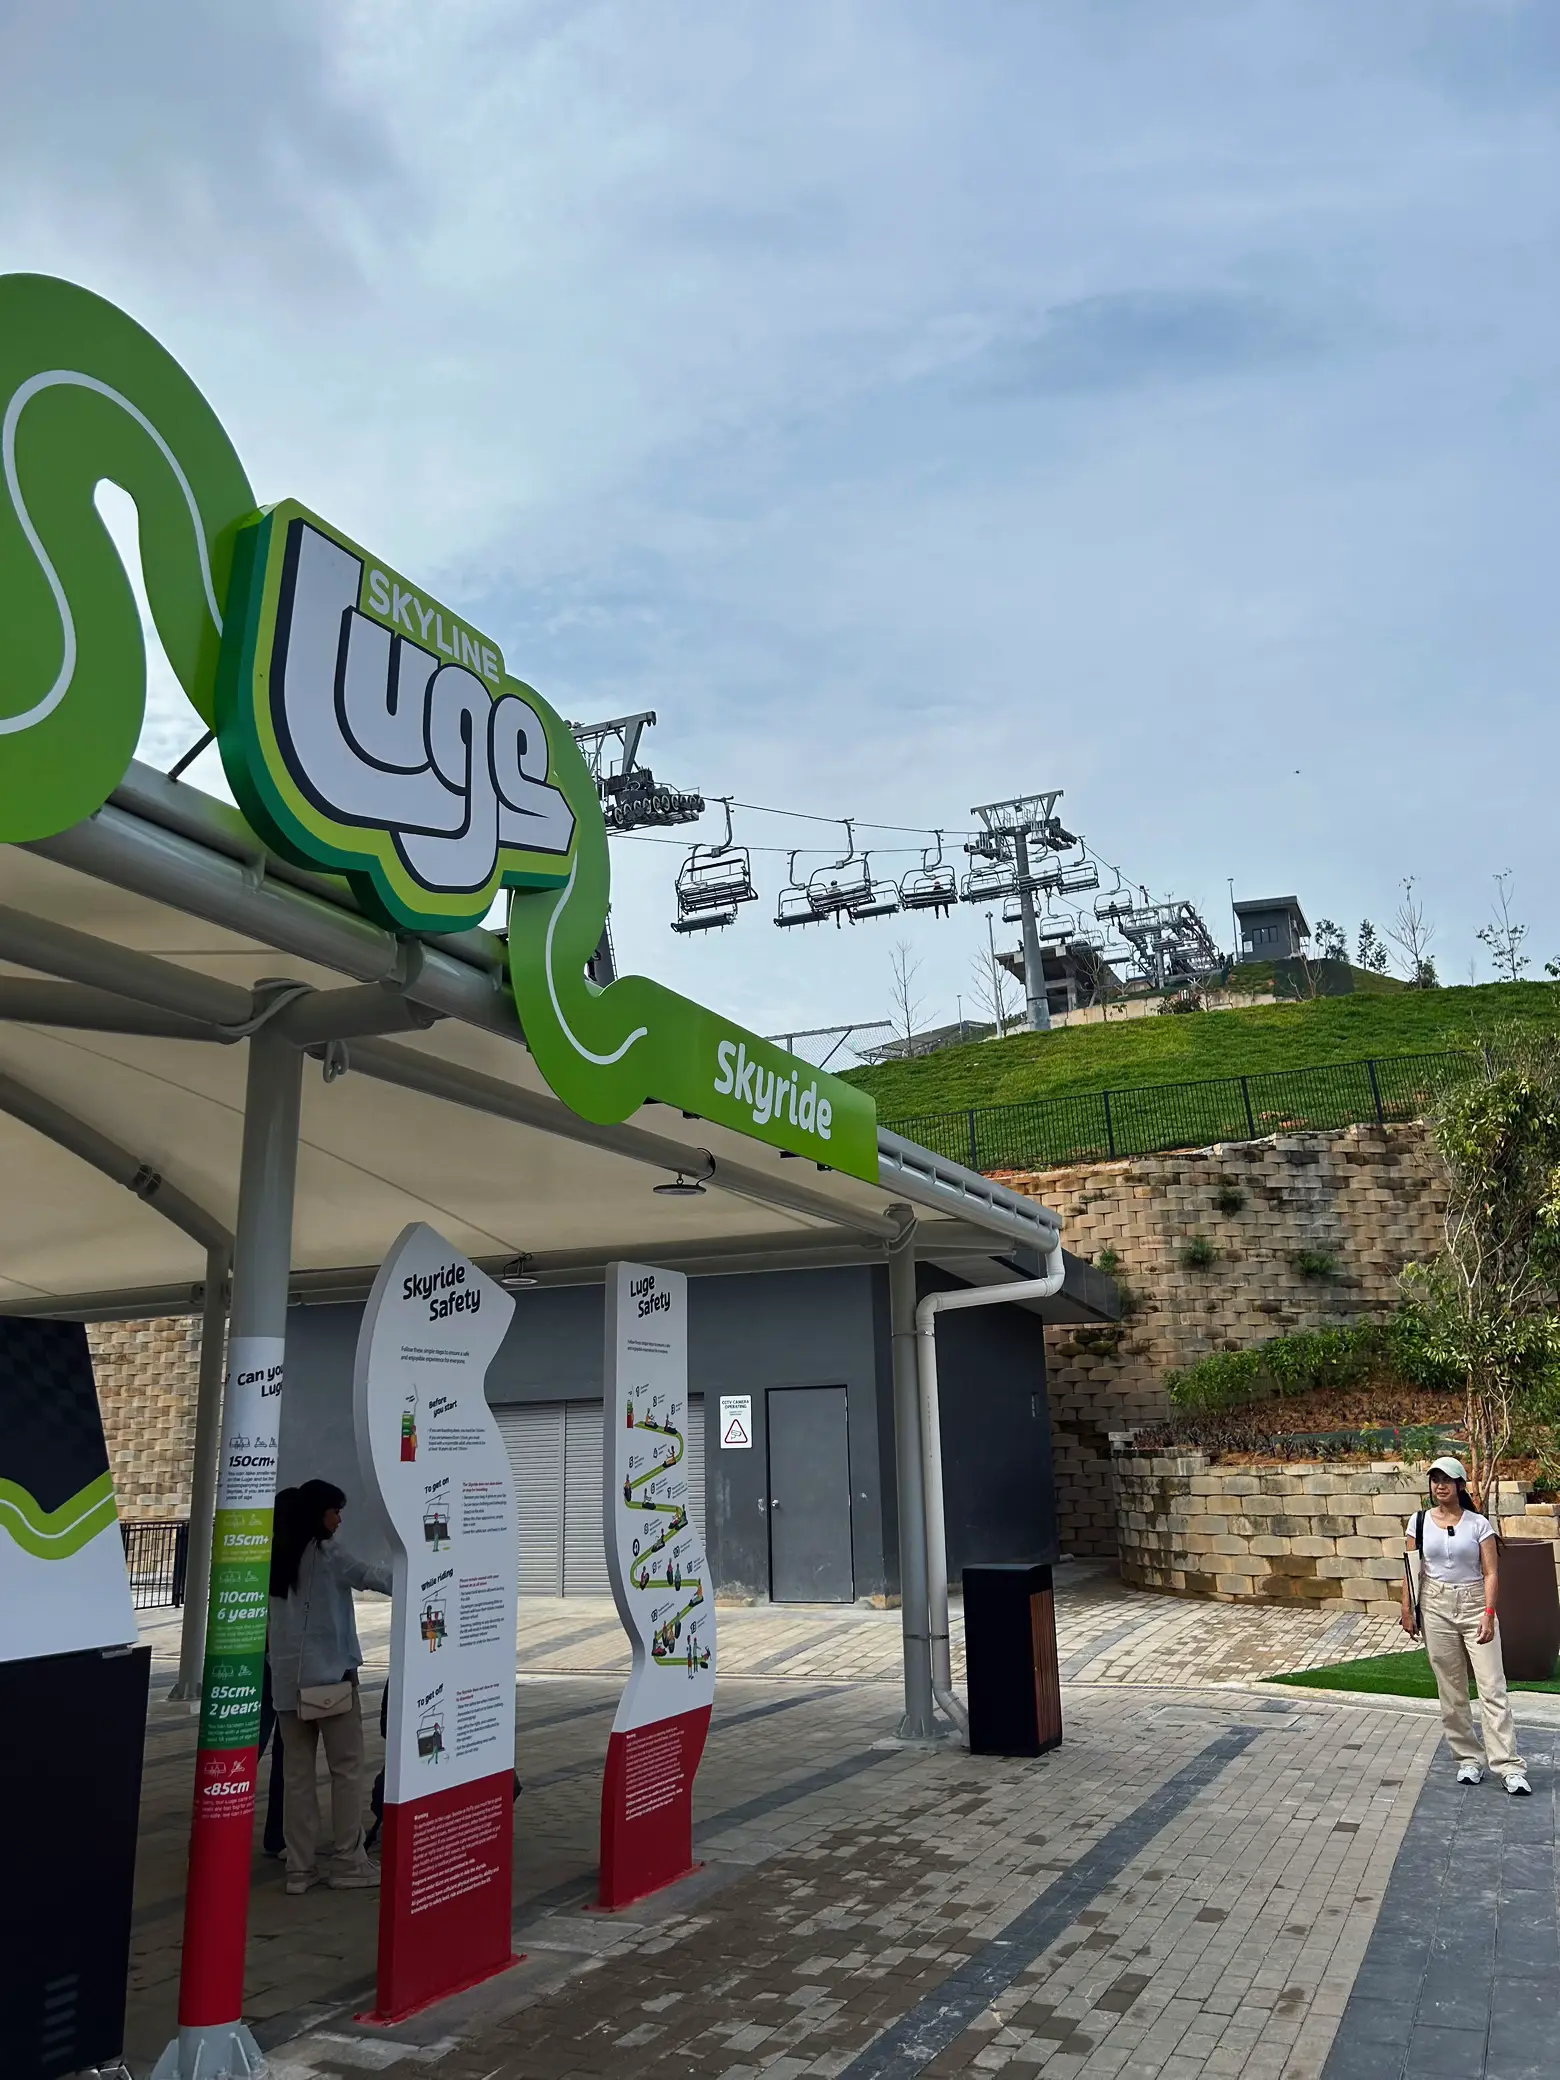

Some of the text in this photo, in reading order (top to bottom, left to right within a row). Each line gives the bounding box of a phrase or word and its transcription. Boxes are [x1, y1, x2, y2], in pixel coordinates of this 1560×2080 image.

[368, 569, 500, 684] SKYLINE
[714, 1040, 832, 1140] Skyride
[403, 1263, 465, 1300] Skyride
[631, 1276, 654, 1297] Luge
[429, 1289, 480, 1321] Safety
[638, 1292, 670, 1318] Safety
[237, 1370, 264, 1387] Can
[268, 1364, 284, 1378] yo
[429, 1396, 447, 1409] Before
[434, 1400, 457, 1418] you start
[229, 1455, 276, 1468] 150cm+
[425, 1477, 449, 1494] To get on
[223, 1534, 269, 1547] 135cm+
[421, 1578, 436, 1591] While
[437, 1568, 453, 1582] riding
[219, 1590, 265, 1604] 110cm+
[217, 1606, 226, 1620] 6
[211, 1686, 257, 1699] 85cm+
[417, 1700, 424, 1708] To
[425, 1691, 435, 1705] get
[435, 1683, 444, 1695] off
[209, 1703, 218, 1716] 2
[203, 1780, 250, 1797] <85cm
